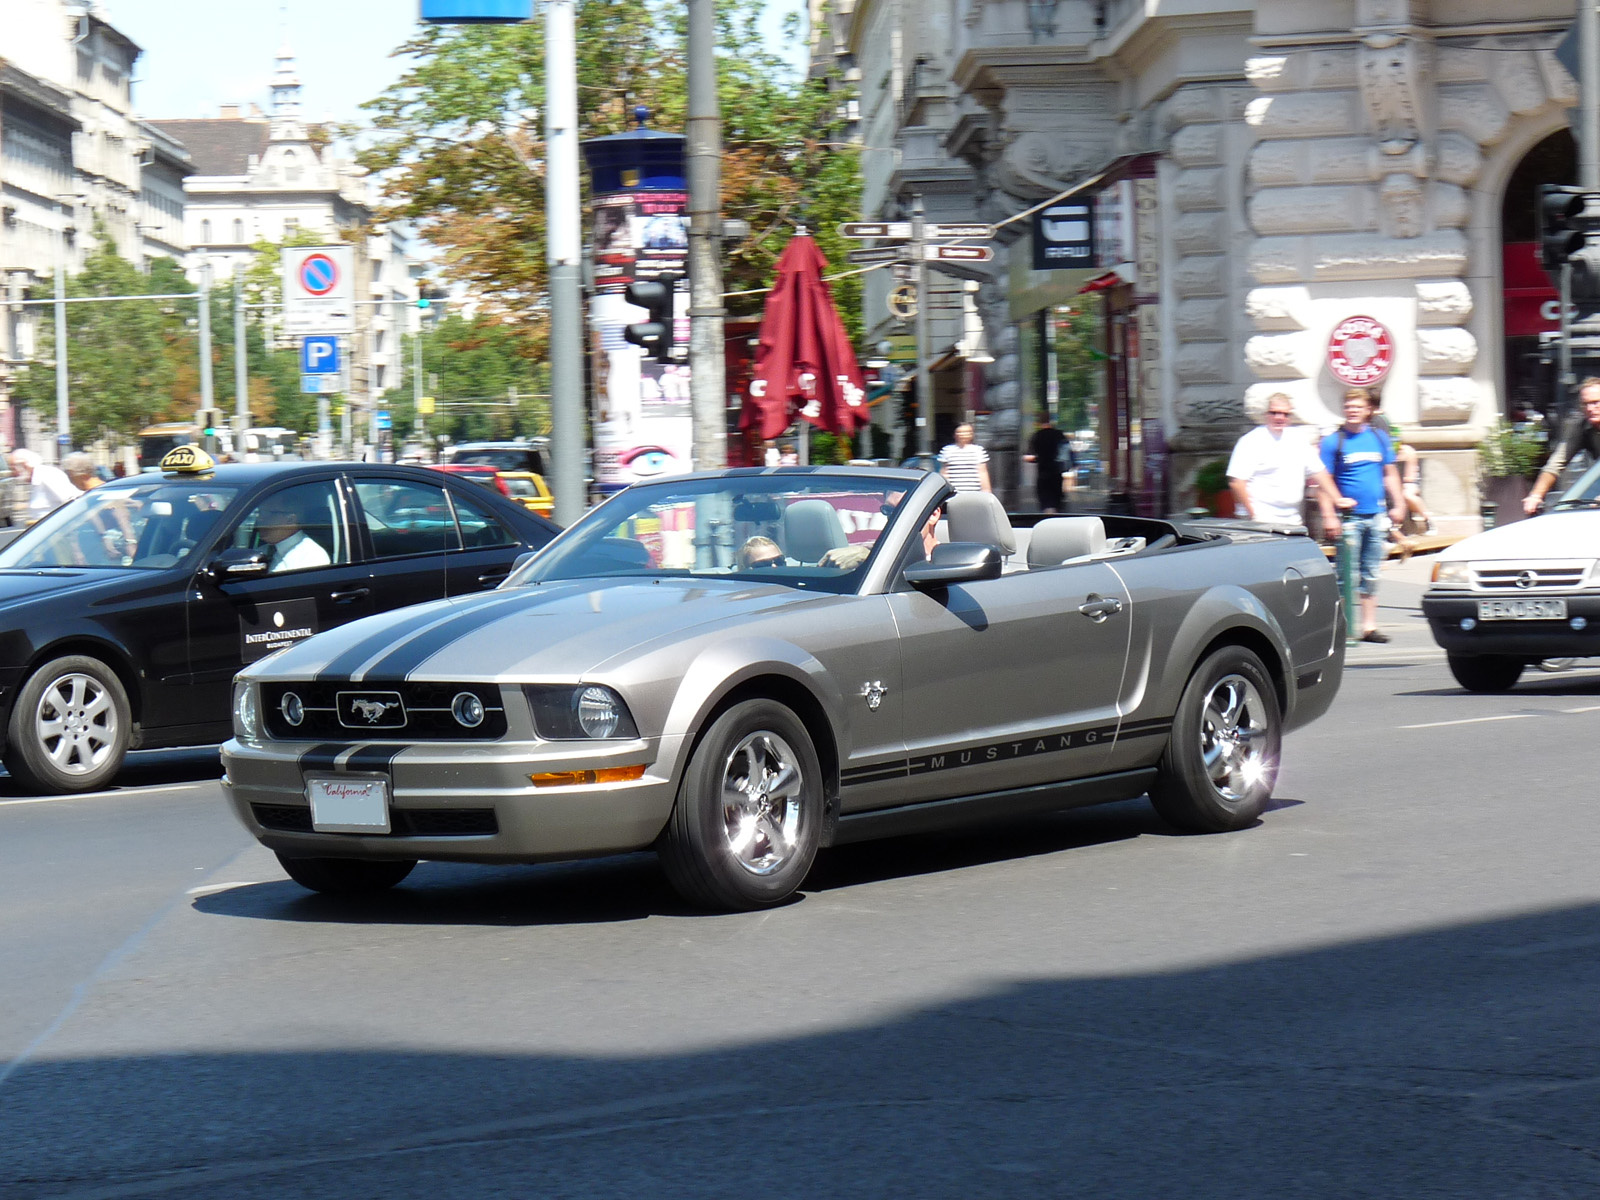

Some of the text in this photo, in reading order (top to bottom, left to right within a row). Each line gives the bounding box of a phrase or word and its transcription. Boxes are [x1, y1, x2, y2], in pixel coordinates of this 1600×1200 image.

[1045, 246, 1090, 258] RAW
[307, 341, 333, 368] P
[164, 453, 195, 466] TAXI
[931, 731, 1097, 769] MUSTANG
[326, 783, 370, 799] California
